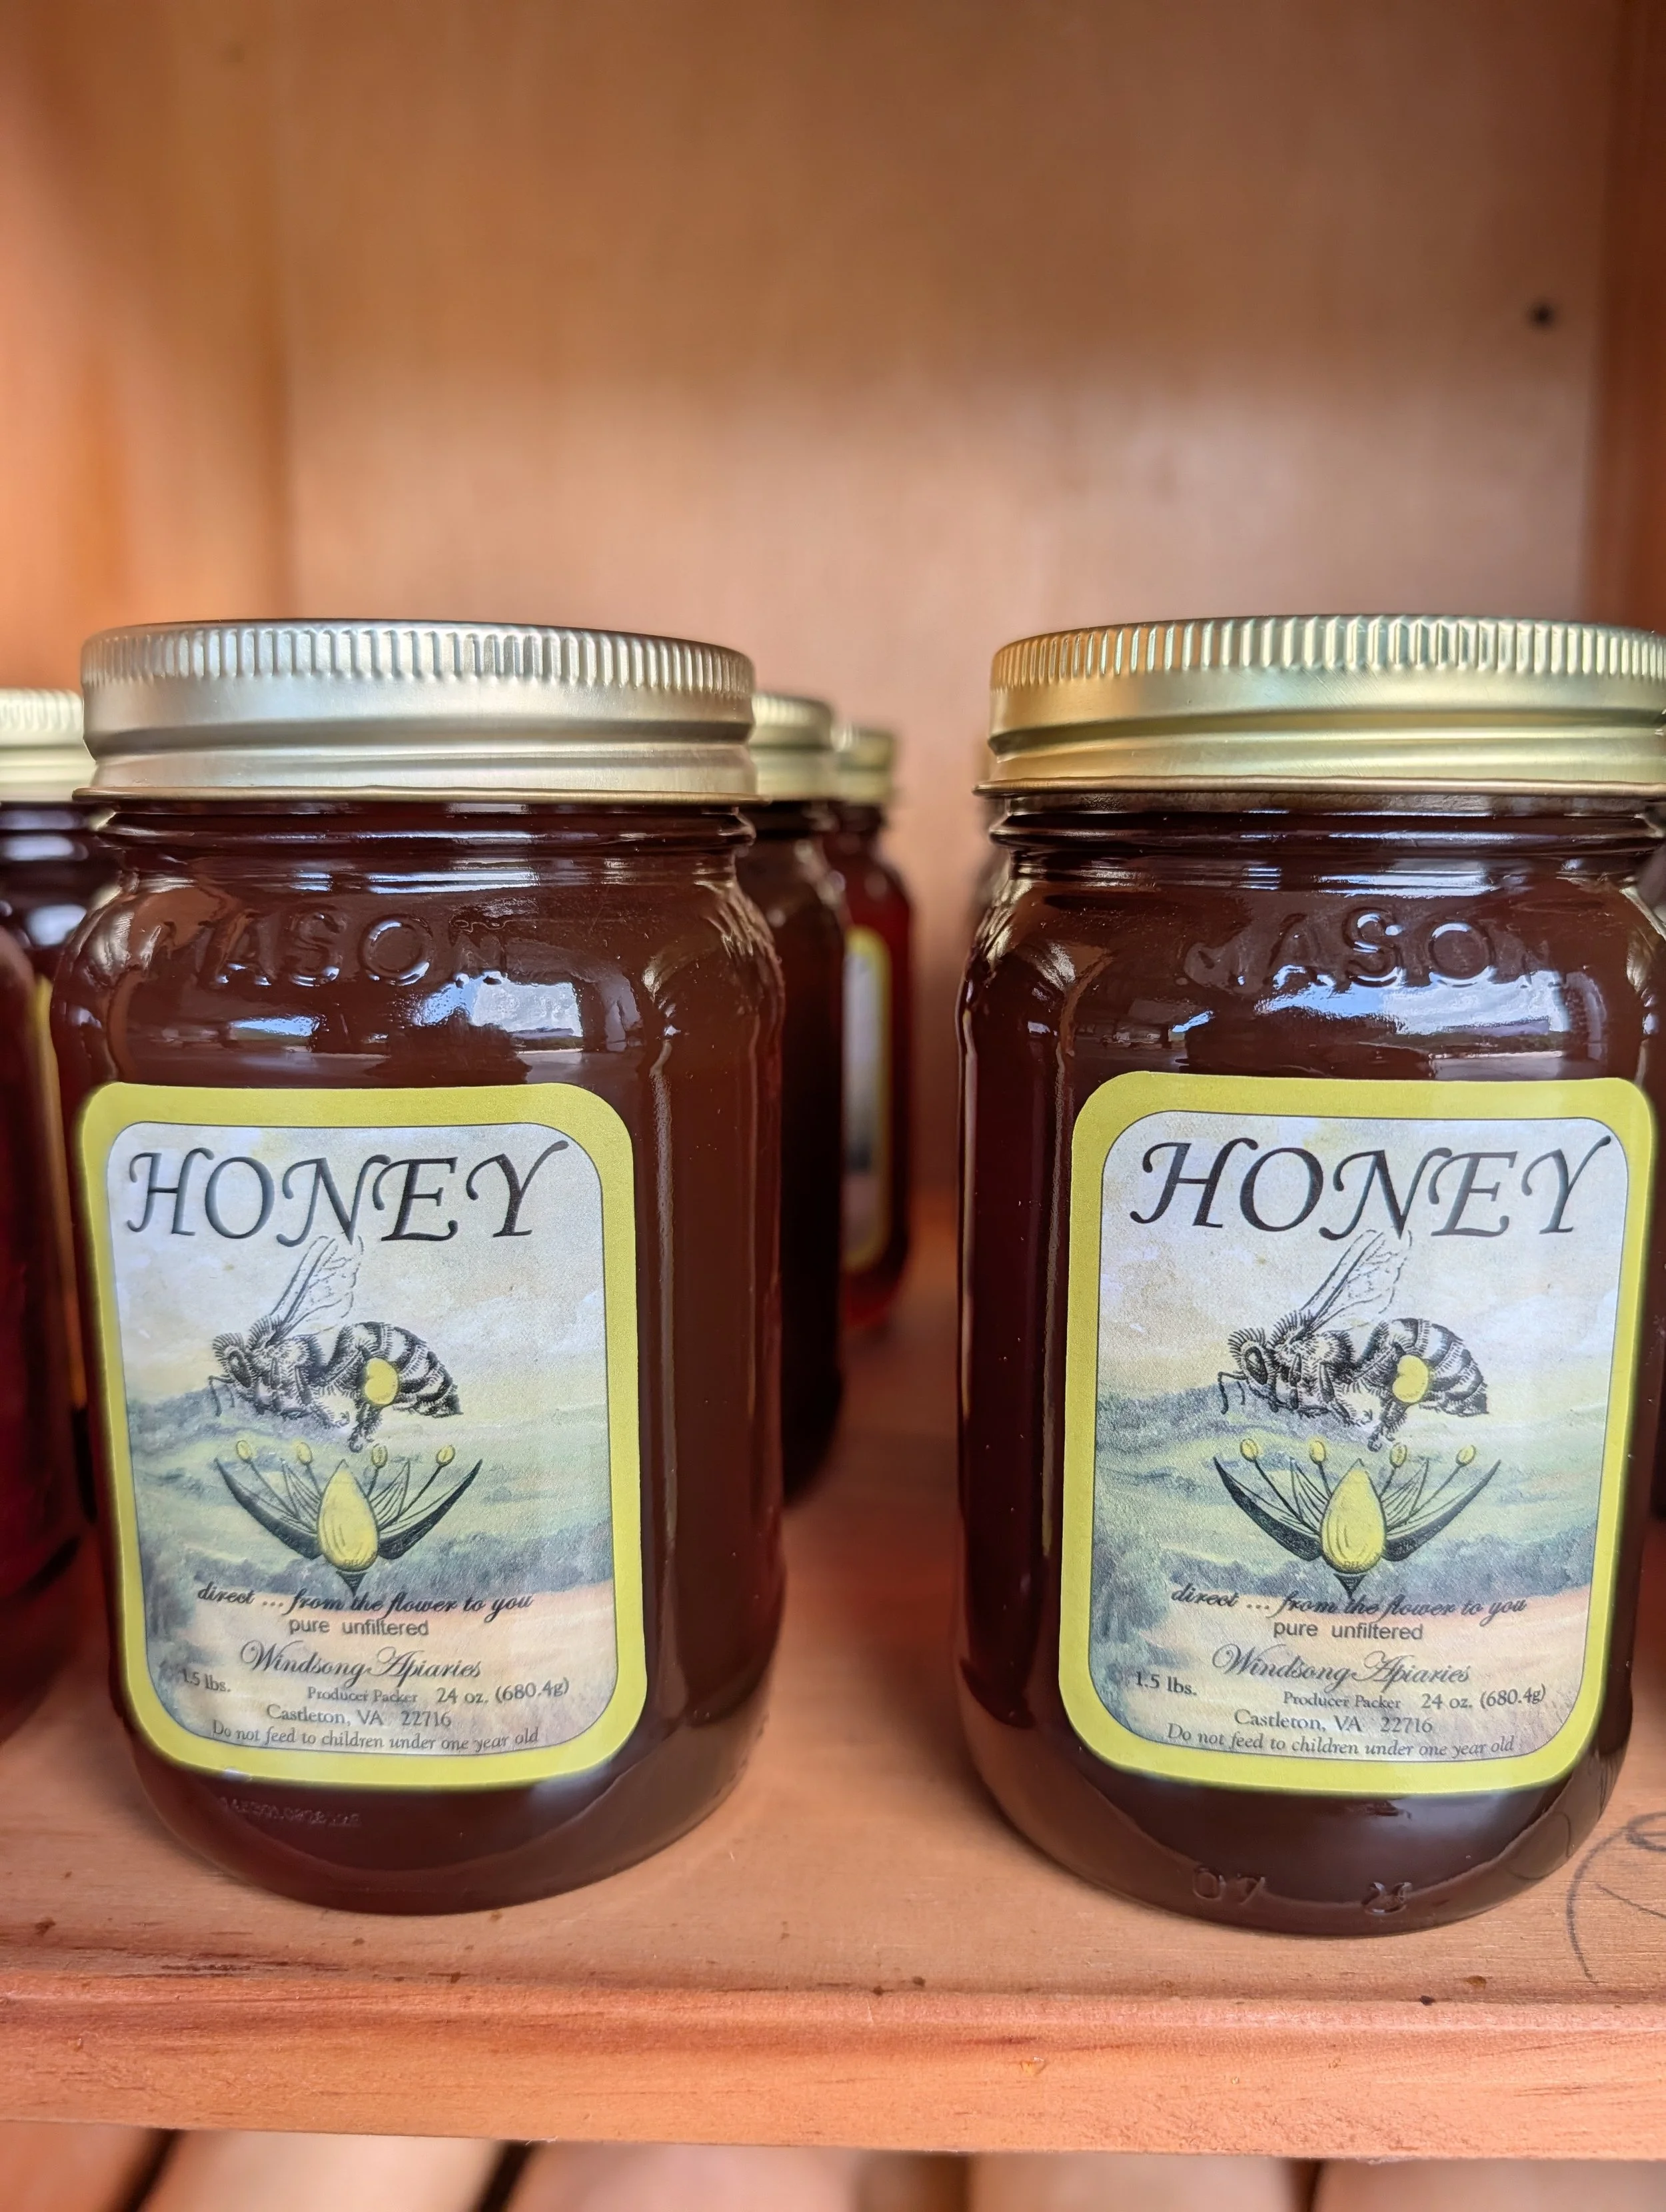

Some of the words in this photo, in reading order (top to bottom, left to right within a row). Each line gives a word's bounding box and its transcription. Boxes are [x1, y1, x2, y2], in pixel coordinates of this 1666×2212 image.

[127, 1140, 568, 1247] HONEY
[1130, 1135, 1611, 1241] HONEY
[198, 1582, 255, 1605] direct
[283, 1589, 344, 1614] from
[351, 1594, 383, 1611] the
[381, 1591, 457, 1619] flower
[464, 1595, 484, 1609] to
[484, 1595, 534, 1623] you
[1172, 1583, 1239, 1608] direct
[1266, 1590, 1337, 1619] from
[1343, 1595, 1379, 1615] the
[1374, 1594, 1457, 1620] flower
[1460, 1600, 1483, 1615] to
[1479, 1599, 1527, 1626] you
[289, 1619, 330, 1636] pure
[343, 1618, 428, 1636] unfiltered
[1273, 1622, 1318, 1640] pure
[1331, 1622, 1423, 1640] unfiltered
[240, 1640, 367, 1688] Windsong
[367, 1646, 482, 1687] Apiaries
[1212, 1643, 1350, 1694] Windsong
[1350, 1650, 1471, 1692] Apiaries
[205, 1674, 231, 1692] lbs.
[308, 1686, 369, 1700] Producer
[373, 1690, 416, 1704] Packer
[436, 1686, 457, 1704] 24
[465, 1692, 488, 1705] oz.
[494, 1678, 569, 1704] (680.4g)
[1135, 1672, 1161, 1689] 1.5
[1167, 1675, 1197, 1696] lbs.
[1283, 1692, 1349, 1708] Producer
[1355, 1696, 1401, 1710] Packer
[1422, 1694, 1442, 1708] 24
[1449, 1698, 1473, 1710] oz.
[1480, 1684, 1546, 1710] (680.4g)
[267, 1704, 351, 1726] Castleton,
[357, 1712, 383, 1726] VA
[401, 1710, 451, 1727] 22716
[1234, 1710, 1326, 1731] Castleton,
[1334, 1716, 1361, 1732] VA
[1380, 1717, 1433, 1732] 22716
[213, 1720, 232, 1738] Do
[237, 1728, 260, 1743] not
[264, 1730, 295, 1747] feed
[301, 1733, 315, 1744] to
[321, 1730, 383, 1747] children
[390, 1736, 435, 1749] under
[441, 1738, 468, 1751] one
[473, 1737, 508, 1752] year
[514, 1728, 538, 1744] old
[1168, 1723, 1192, 1740] Do
[1199, 1734, 1224, 1746] not
[1230, 1731, 1263, 1750] feed
[1269, 1737, 1285, 1748] to
[1292, 1735, 1358, 1754] children
[1365, 1740, 1412, 1754] under
[1419, 1742, 1447, 1756] one
[1452, 1742, 1485, 1758] year
[1491, 1735, 1514, 1753] old
